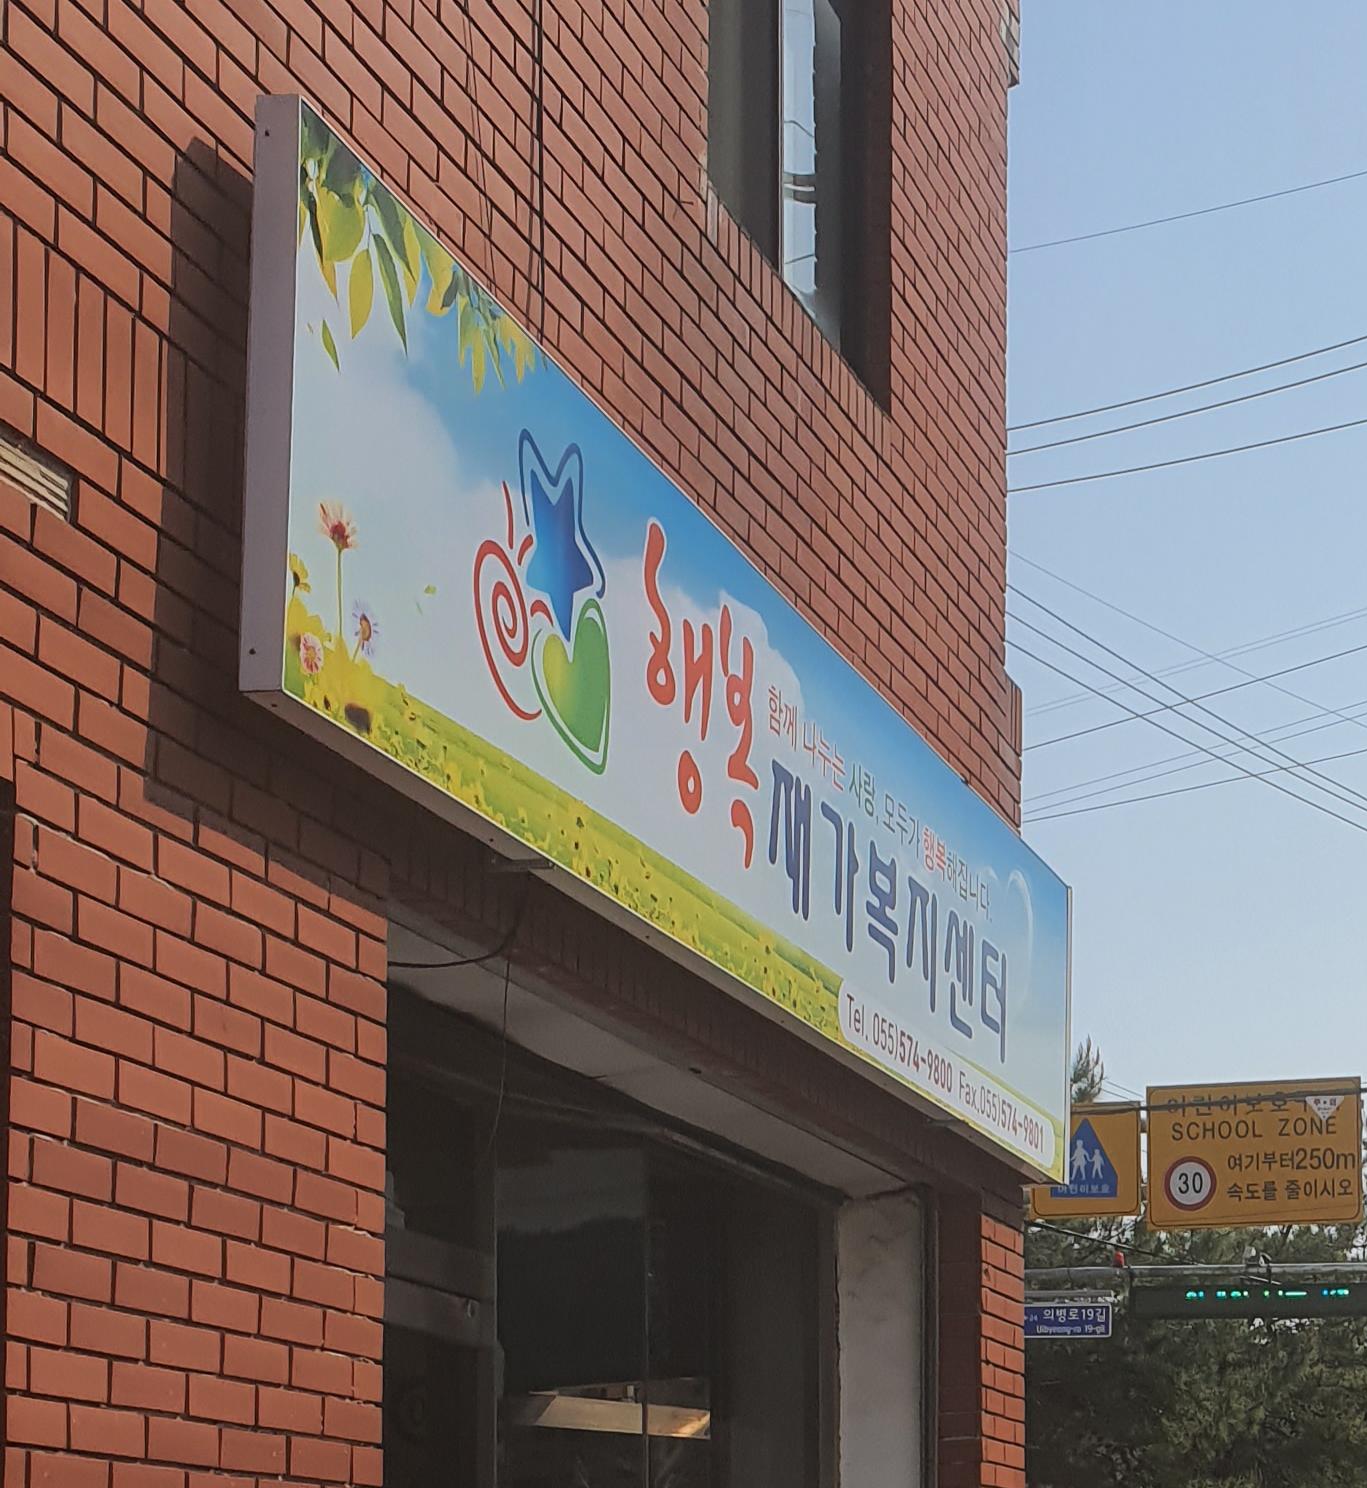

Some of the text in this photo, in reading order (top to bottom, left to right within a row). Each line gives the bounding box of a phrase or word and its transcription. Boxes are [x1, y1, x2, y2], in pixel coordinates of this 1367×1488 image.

[644, 521, 1007, 1065] 행복 재가복지센터
[768, 686, 993, 923] 함께 나누는 사랑, 모두가 행복해집니다.
[846, 994, 869, 1041] Tel.
[872, 1012, 953, 1093] 055)574-9800
[1171, 1115, 1337, 1141] SCHOOL ZONE
[1178, 1172, 1203, 1194] 30
[1226, 1178, 1354, 1202] 속도를 줄이시오
[1043, 1307, 1106, 1322] 의병로19길
